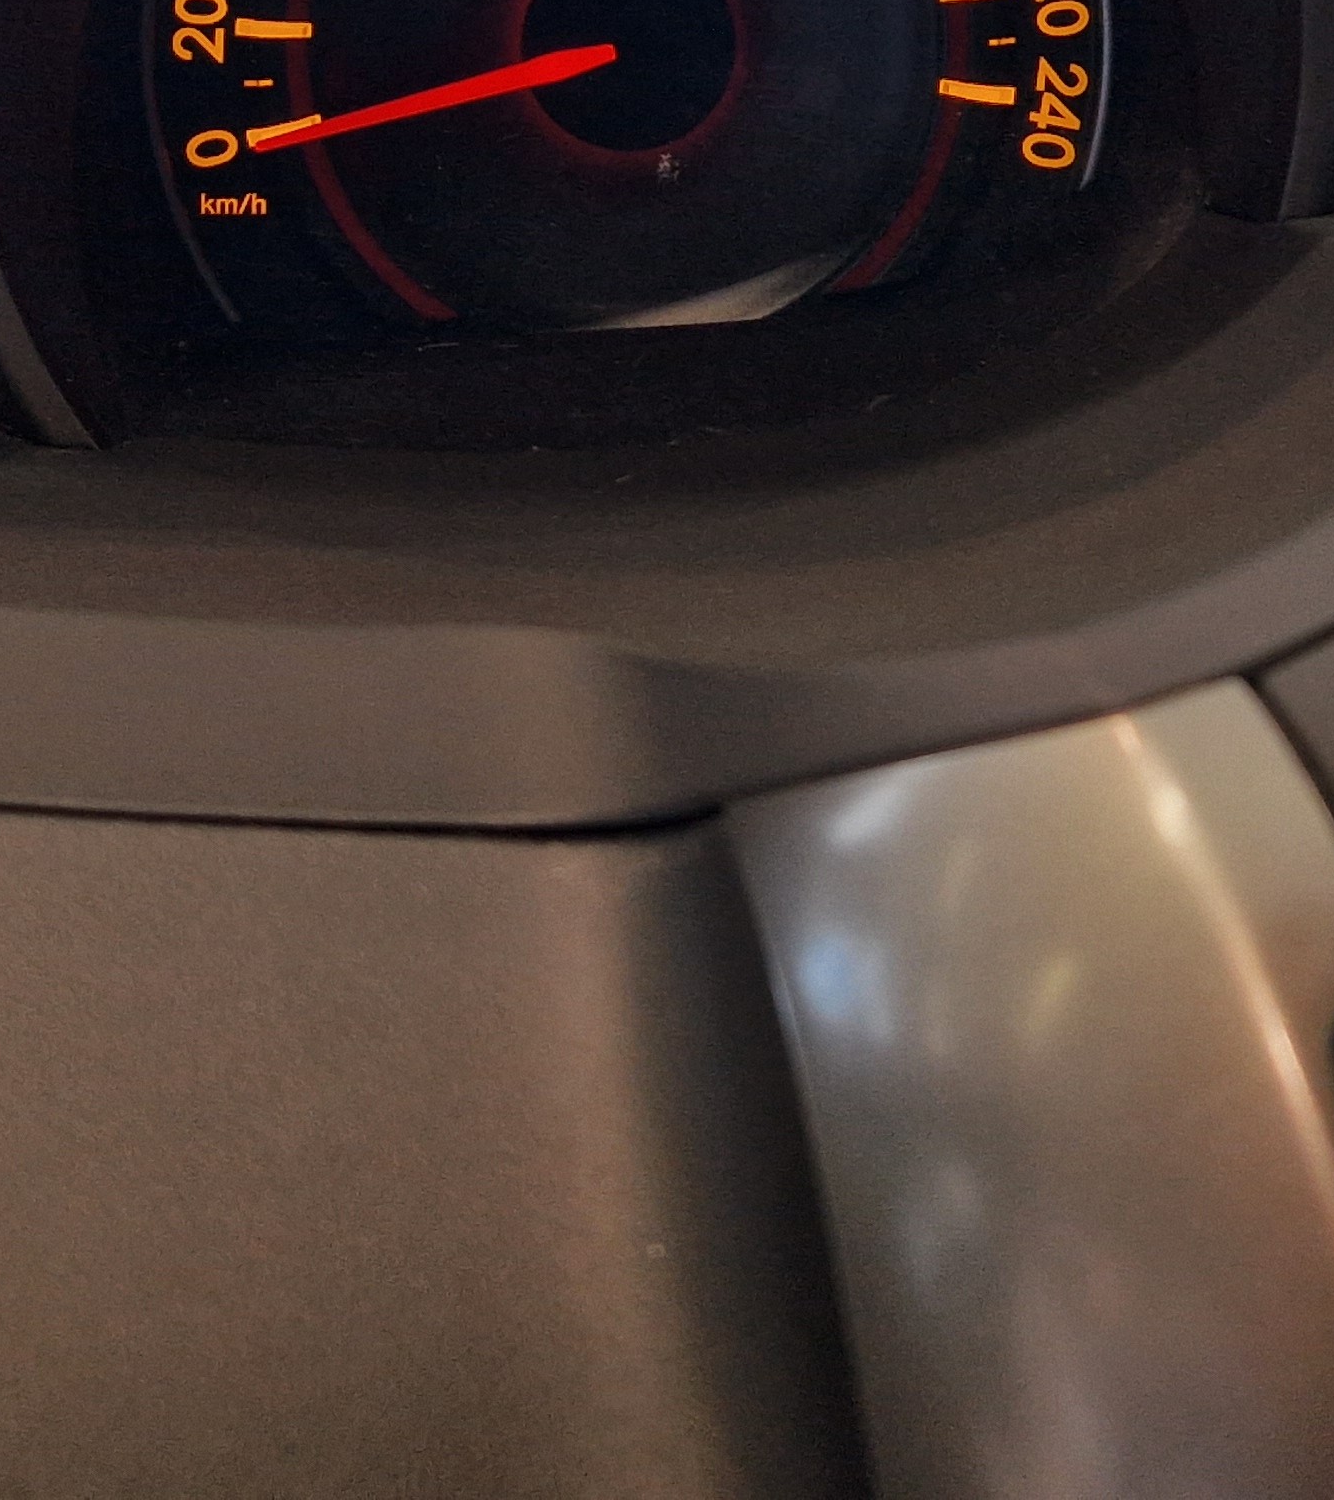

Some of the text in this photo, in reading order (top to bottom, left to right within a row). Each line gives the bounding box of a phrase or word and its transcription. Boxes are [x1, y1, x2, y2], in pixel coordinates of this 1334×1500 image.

[1021, 56, 1089, 169] 240
[185, 129, 239, 168] 0
[200, 192, 267, 215] km/h
